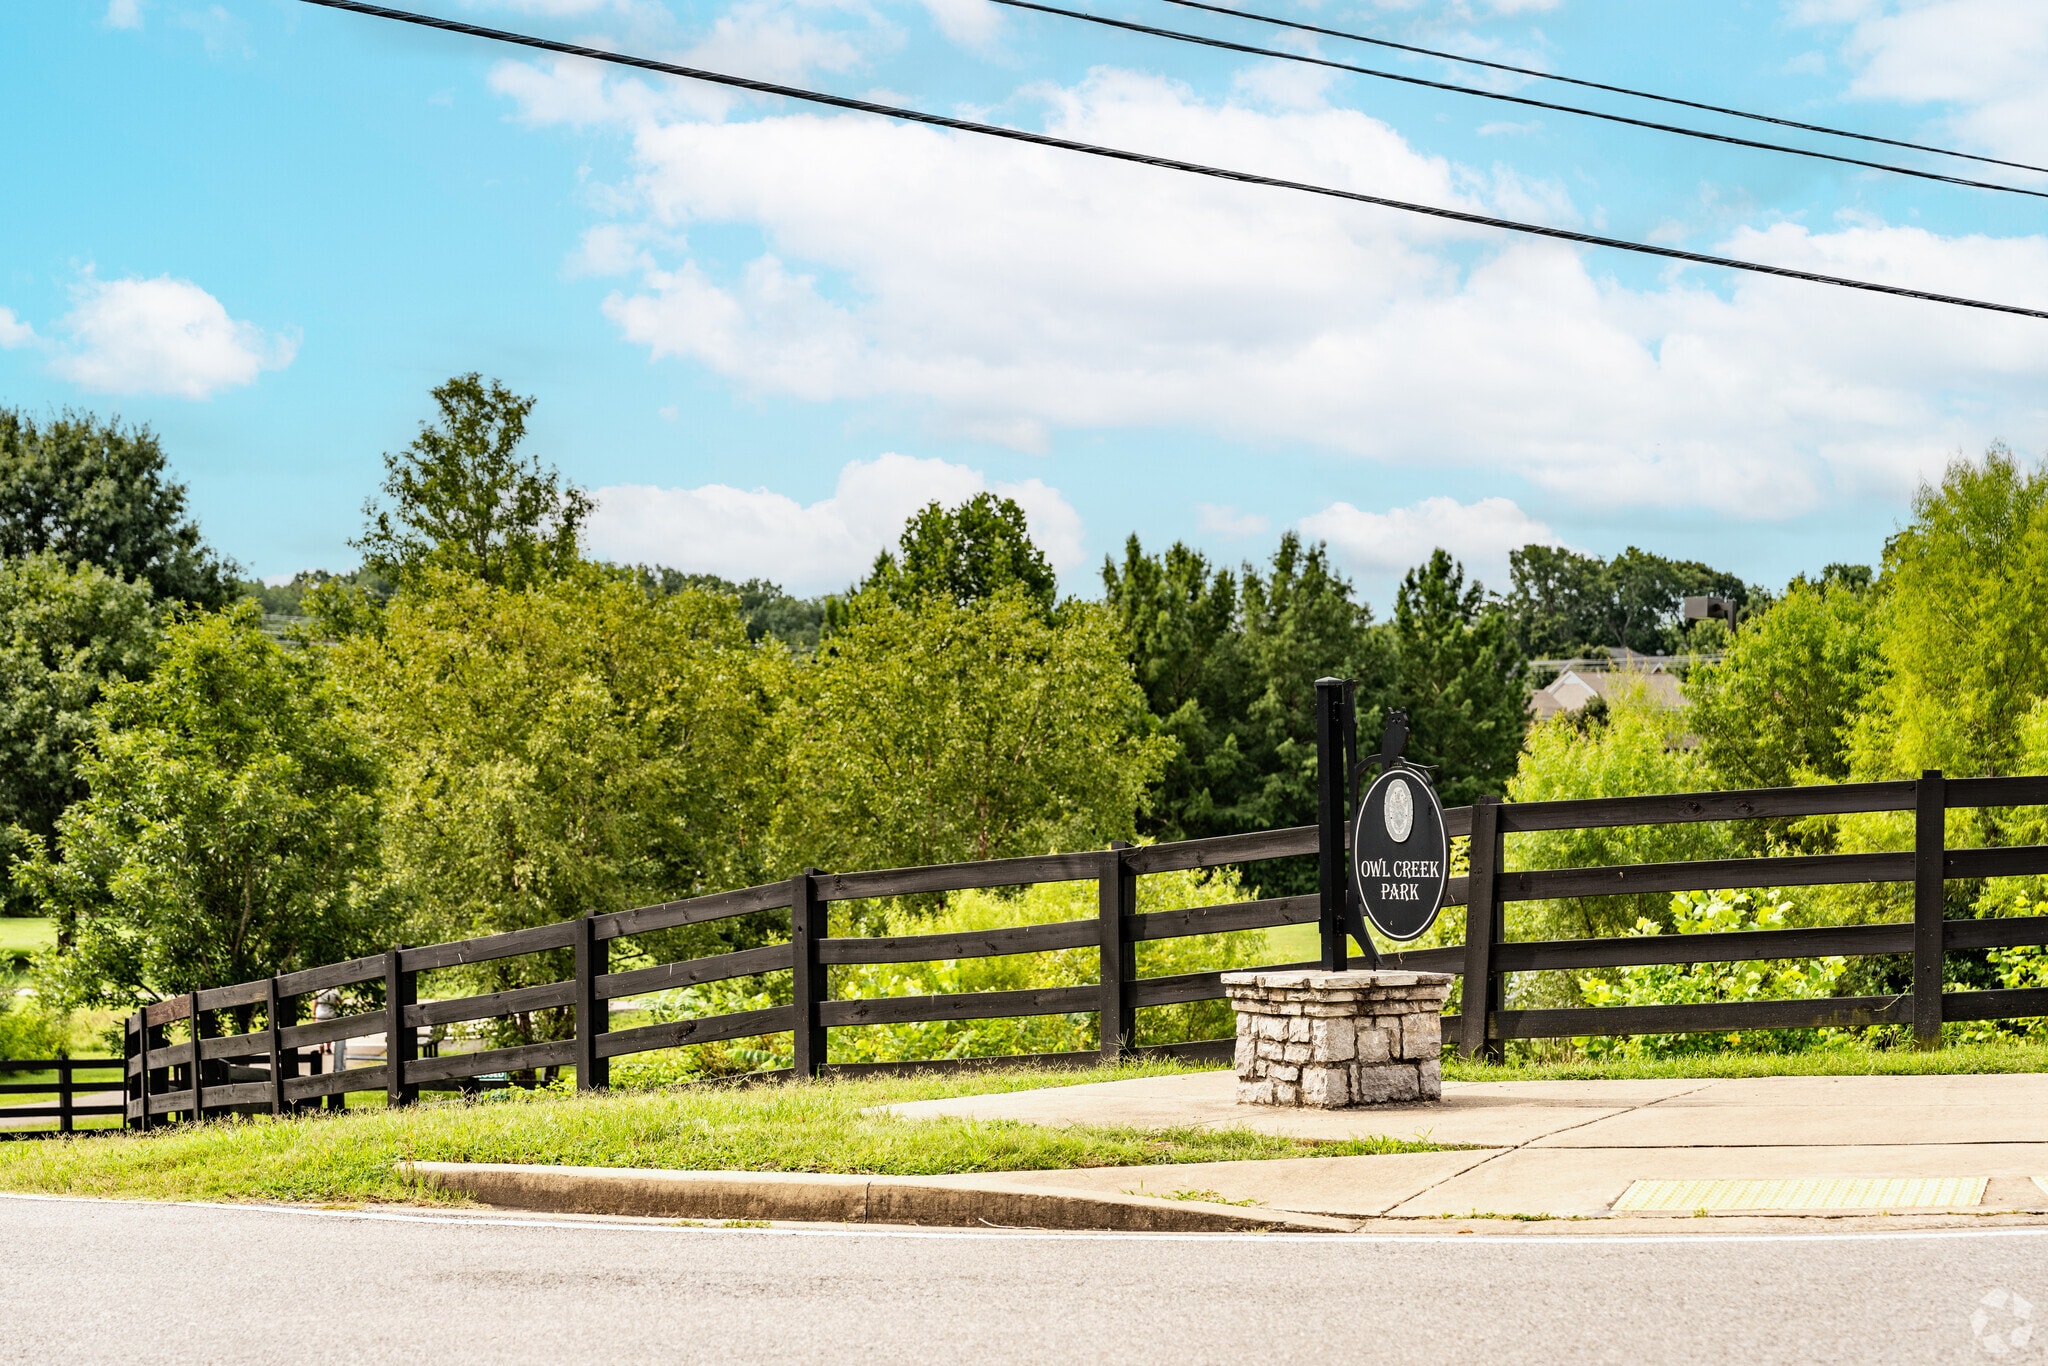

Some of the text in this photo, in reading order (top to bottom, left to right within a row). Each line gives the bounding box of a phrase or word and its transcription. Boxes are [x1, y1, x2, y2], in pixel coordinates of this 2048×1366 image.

[1361, 858, 1440, 879] OWL CREEK
[1381, 883, 1419, 901] PARK
